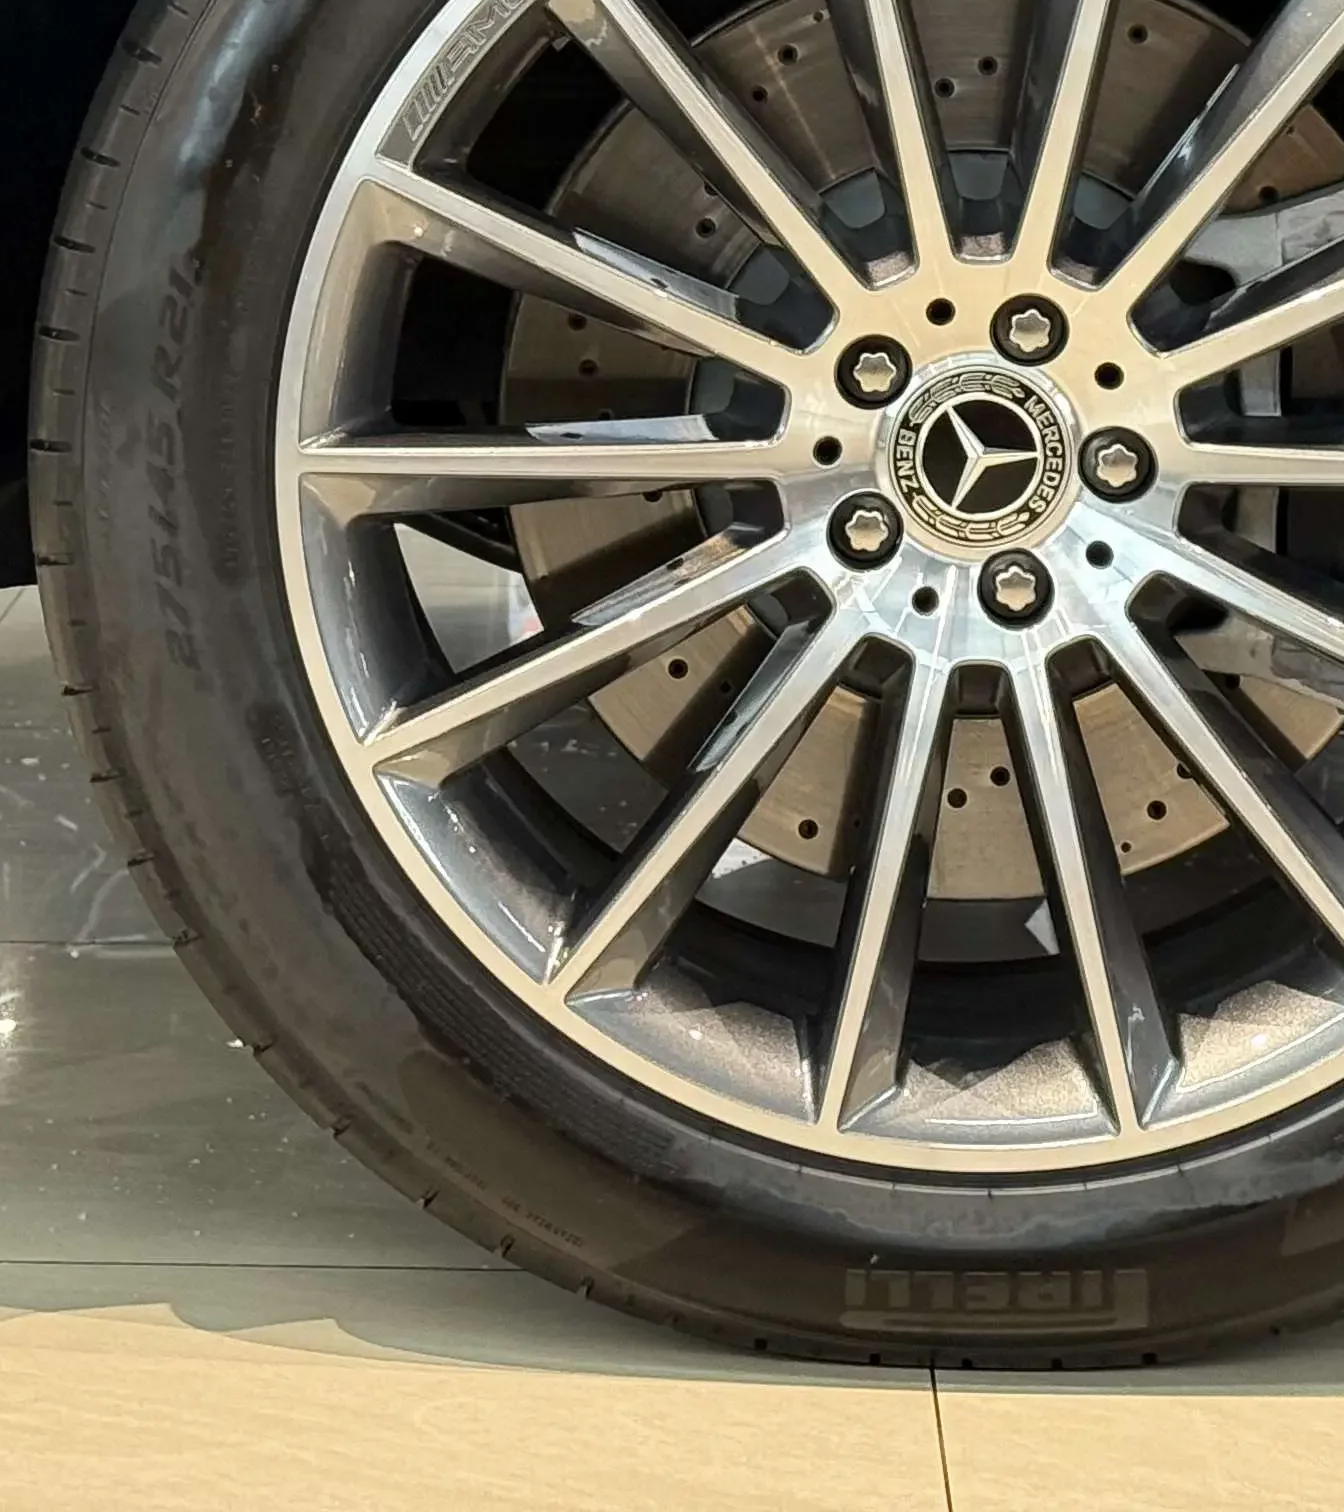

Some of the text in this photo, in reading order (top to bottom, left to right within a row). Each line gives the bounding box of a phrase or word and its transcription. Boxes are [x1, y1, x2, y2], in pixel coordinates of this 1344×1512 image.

[894, 429, 917, 494] BENZ
[1023, 393, 1064, 513] MERCEDES
[839, 1268, 1148, 1333] PIRELLI
